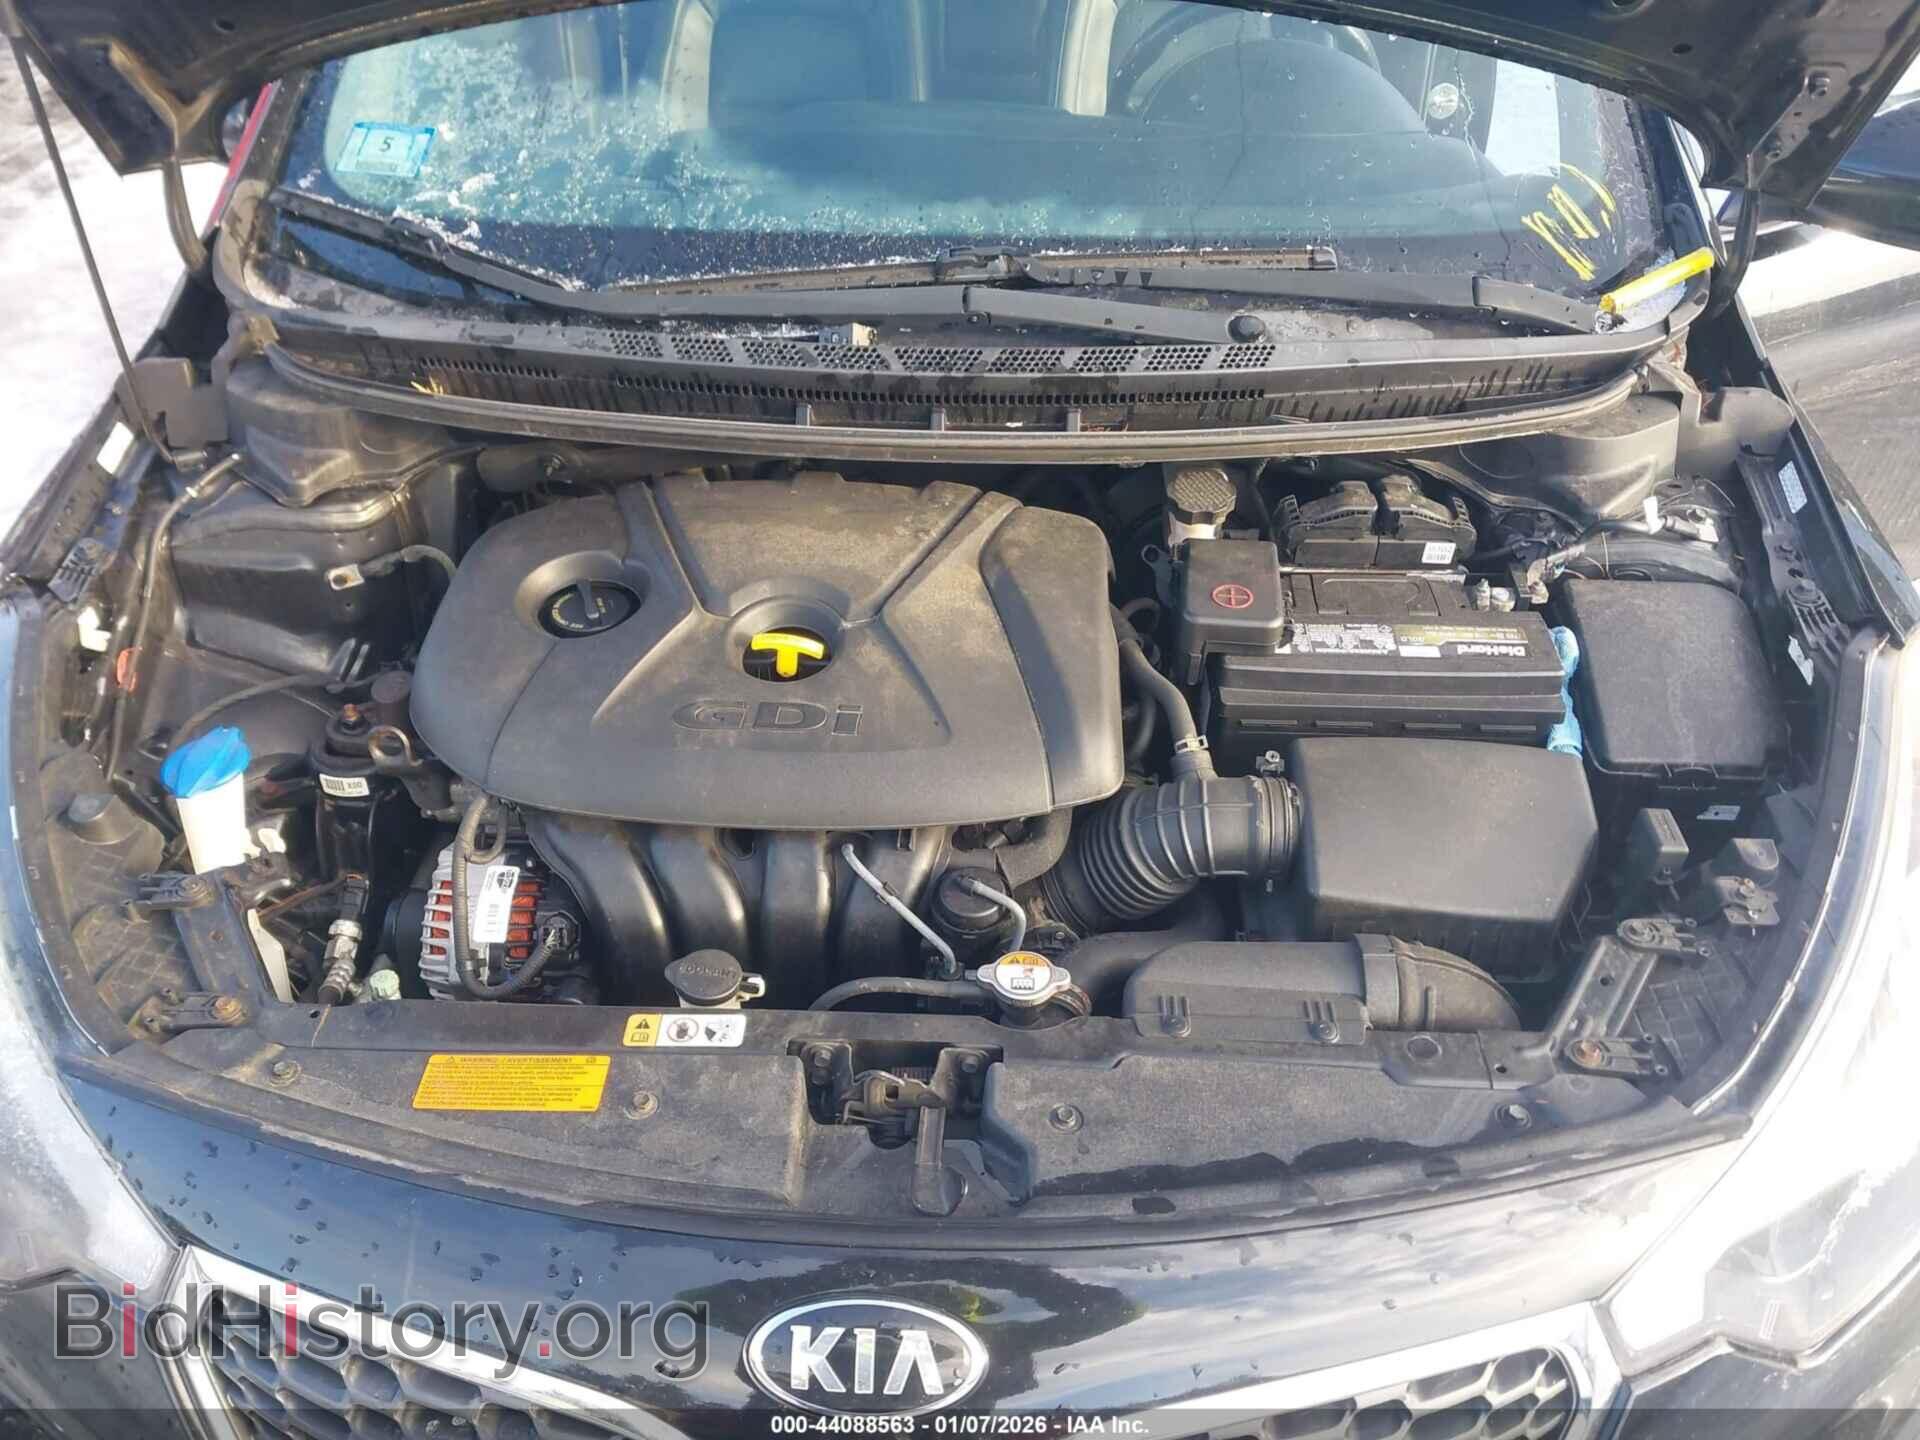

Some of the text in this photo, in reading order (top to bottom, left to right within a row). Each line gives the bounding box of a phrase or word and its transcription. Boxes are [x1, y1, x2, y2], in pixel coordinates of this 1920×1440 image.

[1456, 644, 1526, 657] DieHard
[671, 700, 864, 737] GDi
[789, 1325, 945, 1395] KIA
